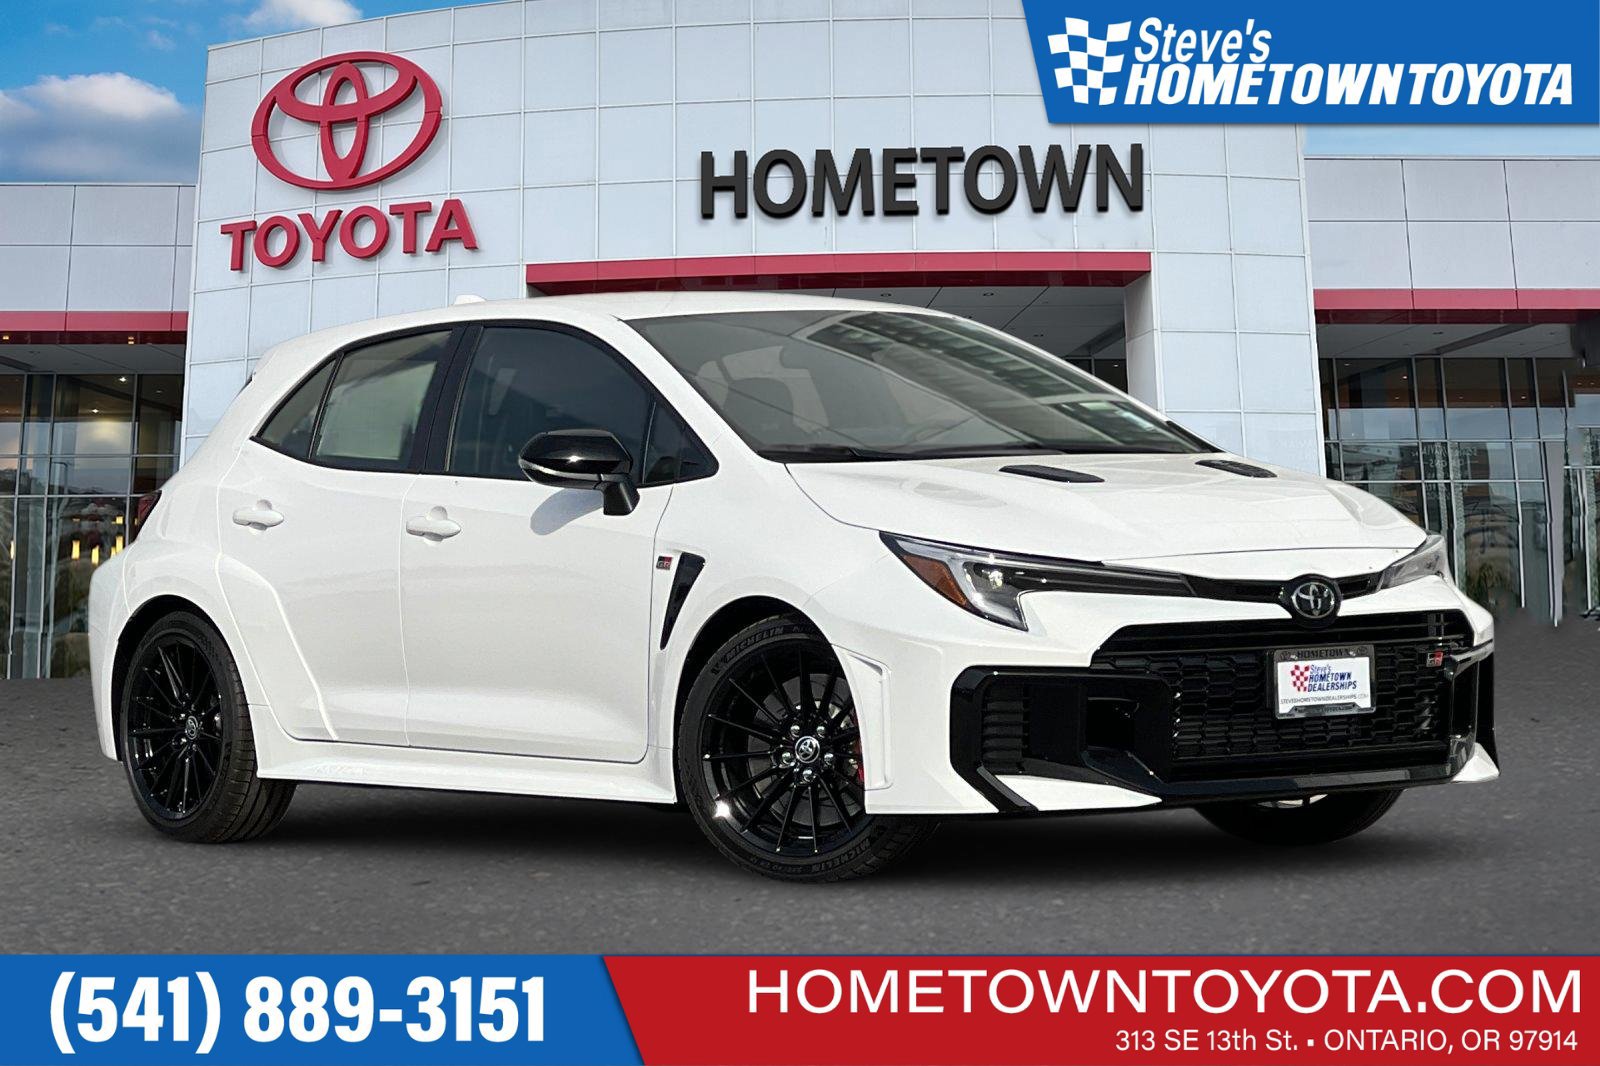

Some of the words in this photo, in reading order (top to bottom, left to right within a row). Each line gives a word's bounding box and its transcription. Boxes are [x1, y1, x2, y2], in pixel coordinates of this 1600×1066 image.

[700, 143, 1145, 220] HOMETOWN
[220, 198, 478, 271] TOYOTA
[1310, 664, 1332, 674] Steve's
[1308, 671, 1353, 683] HOMETOWN
[1307, 680, 1358, 692] DEALERSHIPS
